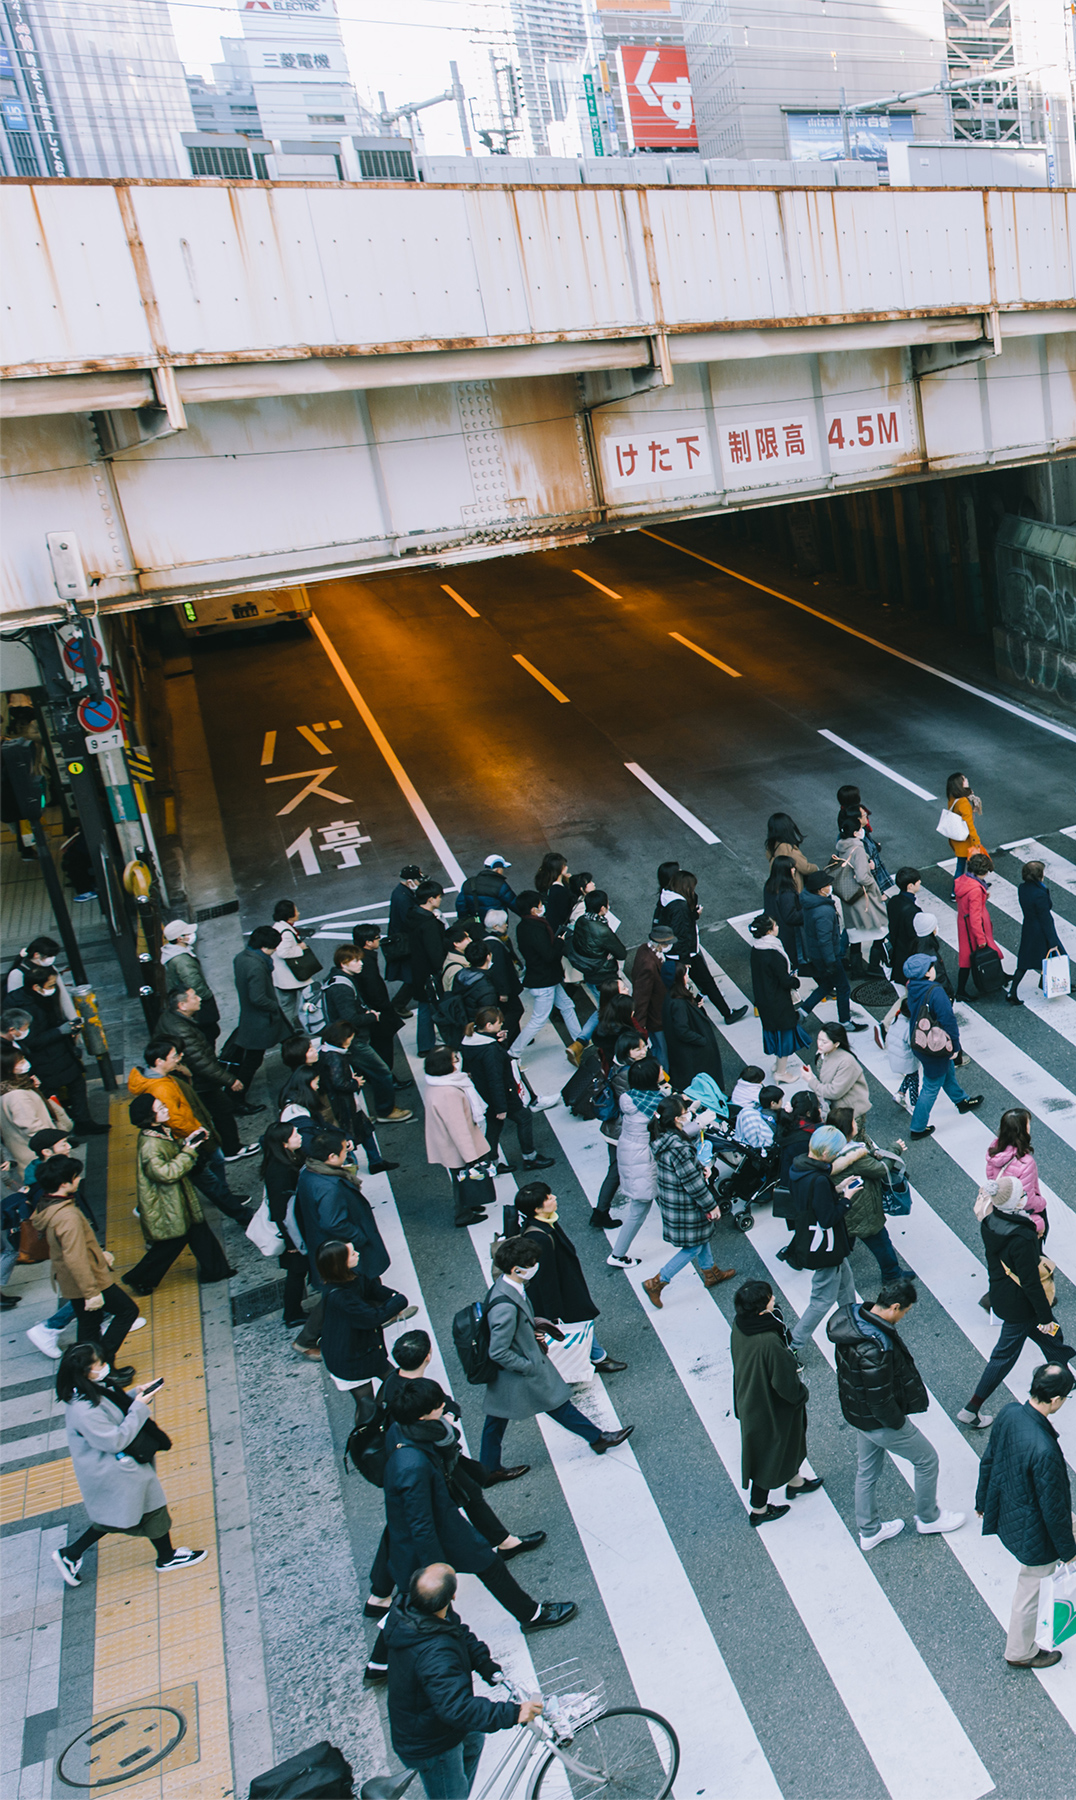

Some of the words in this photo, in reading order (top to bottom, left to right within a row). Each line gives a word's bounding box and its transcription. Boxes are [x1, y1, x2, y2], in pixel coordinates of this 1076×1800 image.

[273, 1, 321, 12] ELECTRIC
[262, 53, 331, 69] 三菱電機
[615, 436, 701, 477] けた下
[728, 424, 805, 465] 制限高
[827, 411, 899, 450] 4.5M
[90, 734, 119, 749] 9-7
[260, 719, 371, 876] バス停
